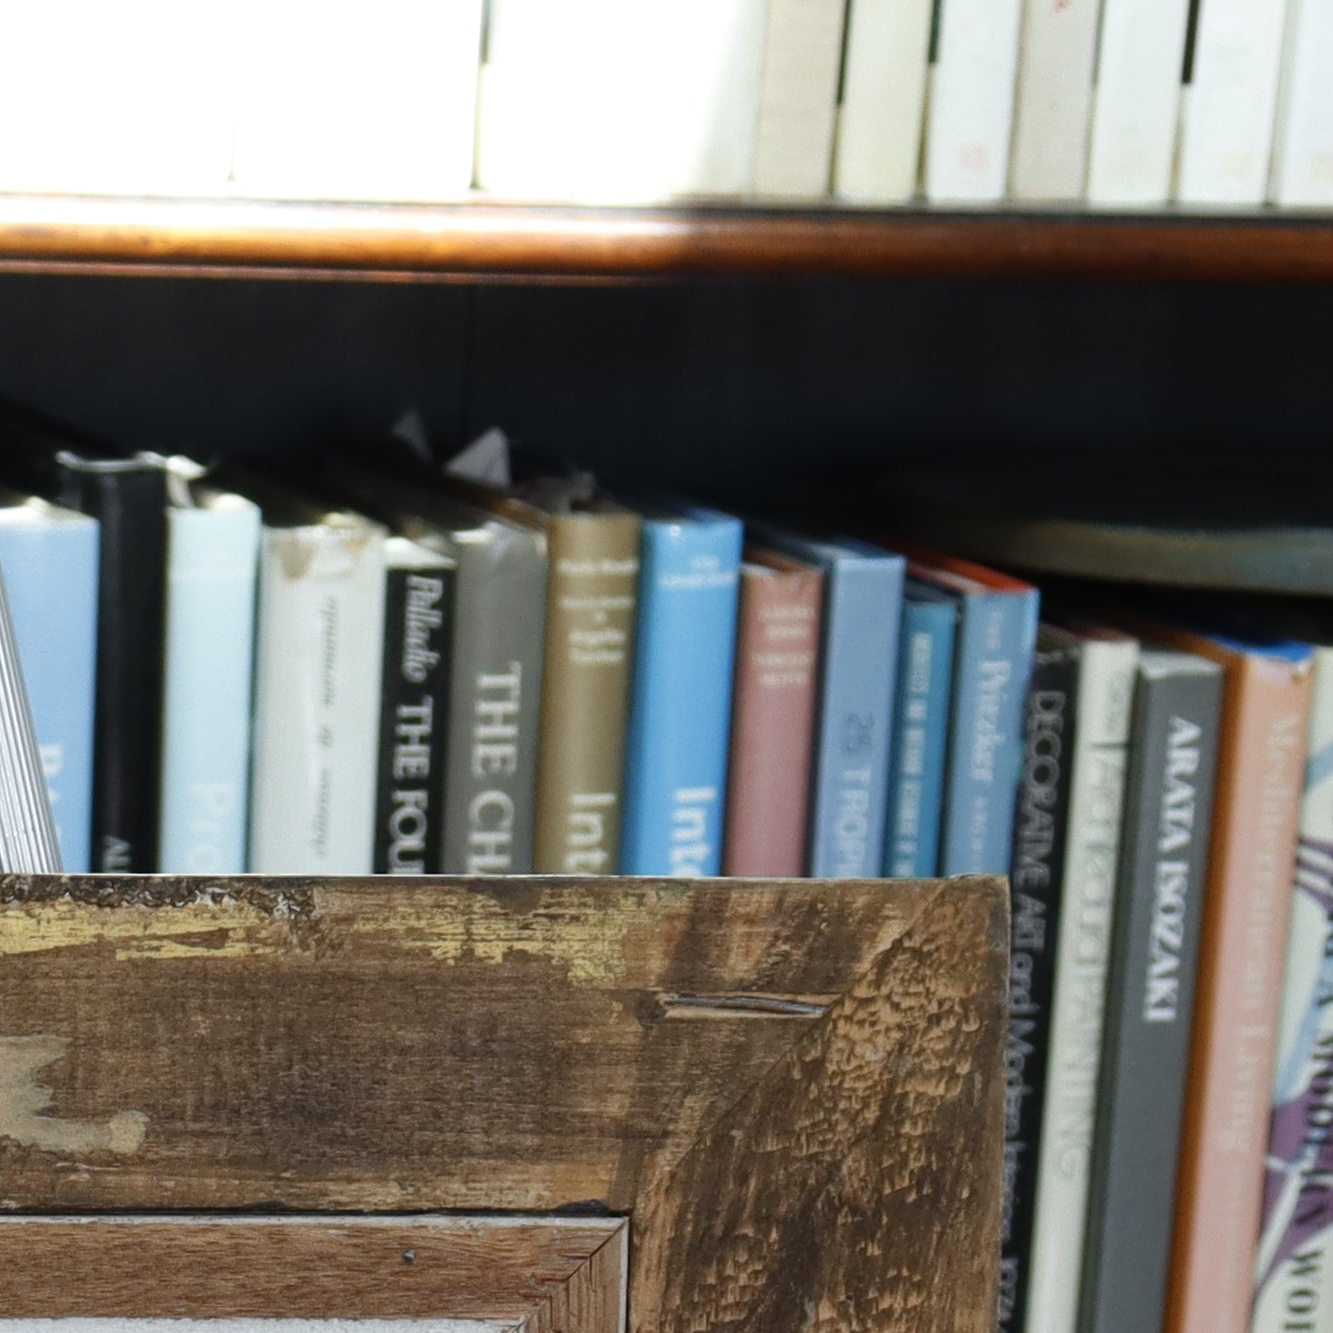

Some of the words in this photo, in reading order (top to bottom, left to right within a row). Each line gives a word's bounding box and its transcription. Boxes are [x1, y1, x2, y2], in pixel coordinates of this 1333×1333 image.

[402, 573, 443, 684] Palladio
[391, 694, 434, 781] THE
[469, 660, 523, 779] THE
[464, 789, 516, 875] CH
[1015, 690, 1066, 889] DECORATIVE
[1157, 714, 1204, 853] ARATA
[1011, 899, 1047, 951] ART
[1143, 862, 1191, 1024] ISOZAKI
[1009, 953, 1037, 1010] and
